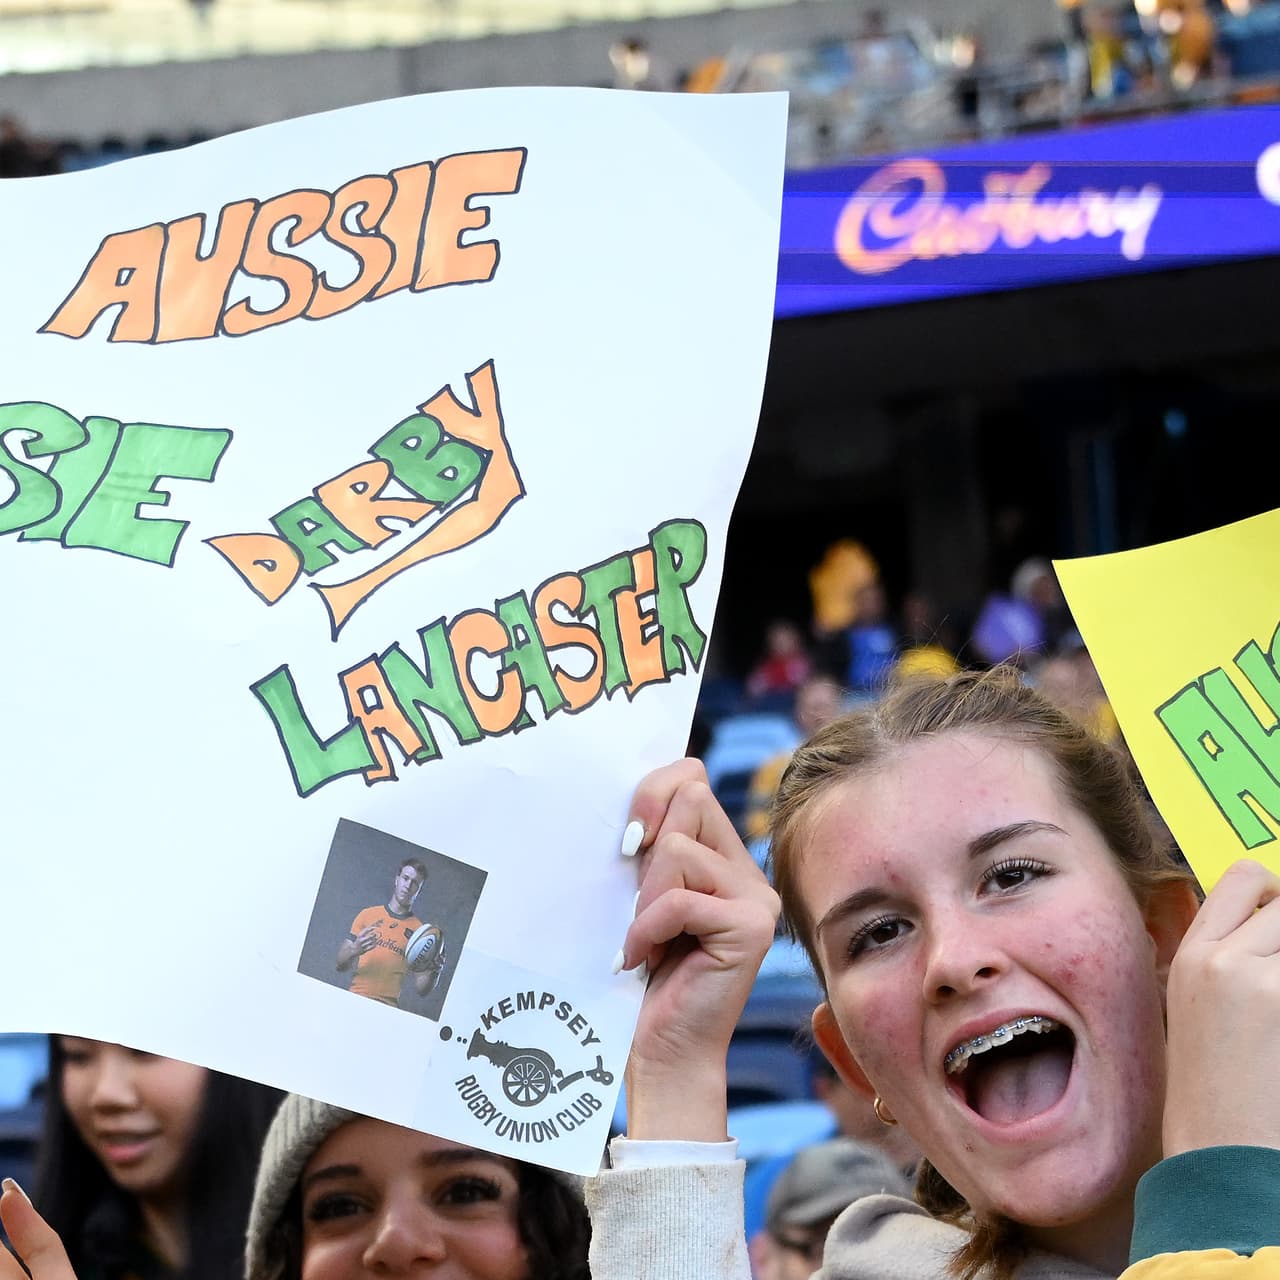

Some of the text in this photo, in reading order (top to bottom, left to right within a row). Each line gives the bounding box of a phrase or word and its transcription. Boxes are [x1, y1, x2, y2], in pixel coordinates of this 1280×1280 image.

[37, 147, 528, 344] AUSSIE
[833, 157, 1163, 275] Cadbury
[202, 359, 527, 642] DARBY
[249, 518, 708, 799] LANCASTER
[480, 991, 601, 1047] KEMPSEY
[455, 1074, 603, 1143] RUGBY UNION CLUB
